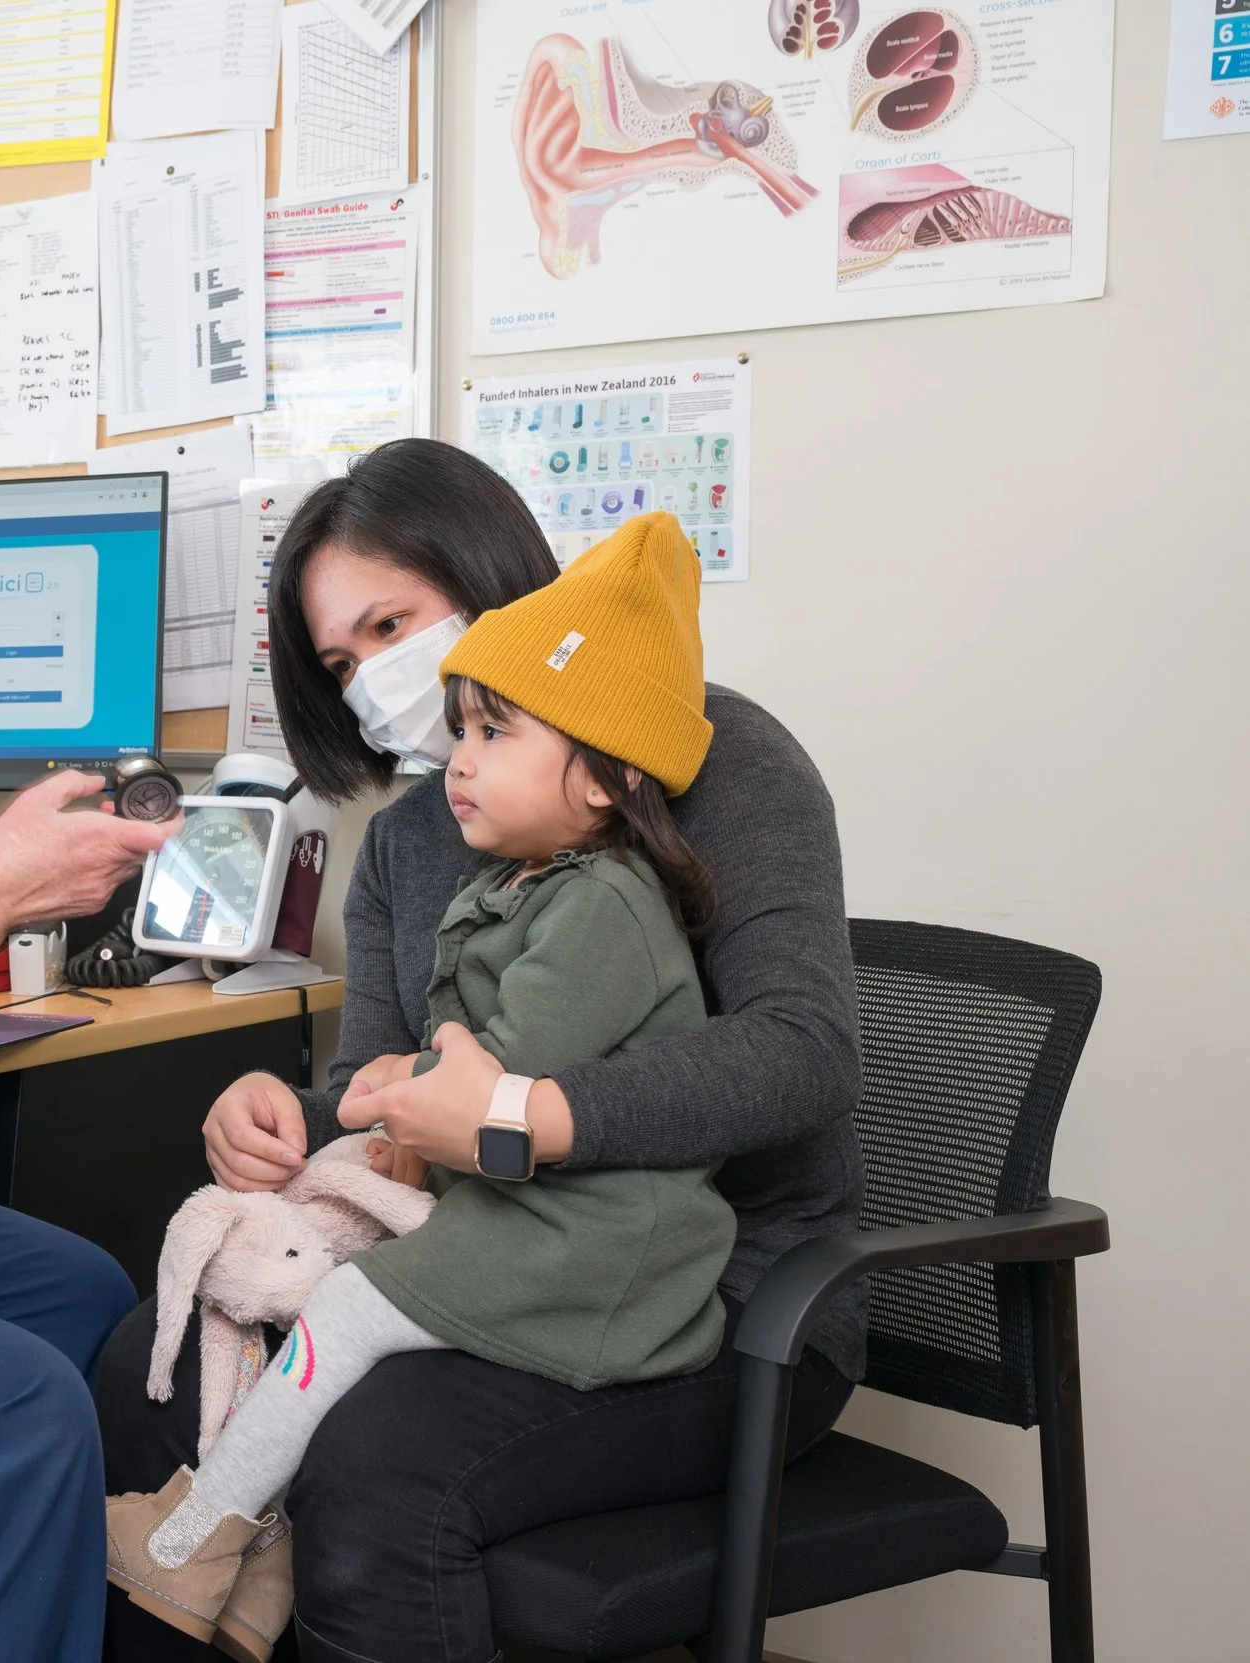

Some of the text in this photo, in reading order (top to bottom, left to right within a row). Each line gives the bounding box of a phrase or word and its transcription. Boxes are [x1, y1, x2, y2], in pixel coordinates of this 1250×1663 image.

[1219, 23, 1234, 44] 6
[1218, 55, 1232, 76] 7
[855, 151, 941, 171] Organ of Corti
[317, 205, 341, 216] Swab
[343, 202, 369, 213] Guide
[490, 315, 515, 326] 0800
[538, 311, 556, 321] 854
[479, 375, 676, 402] Funded Inhalers in New Zealand 2016
[231, 831, 243, 840] 180
[244, 860, 257, 869] 220
